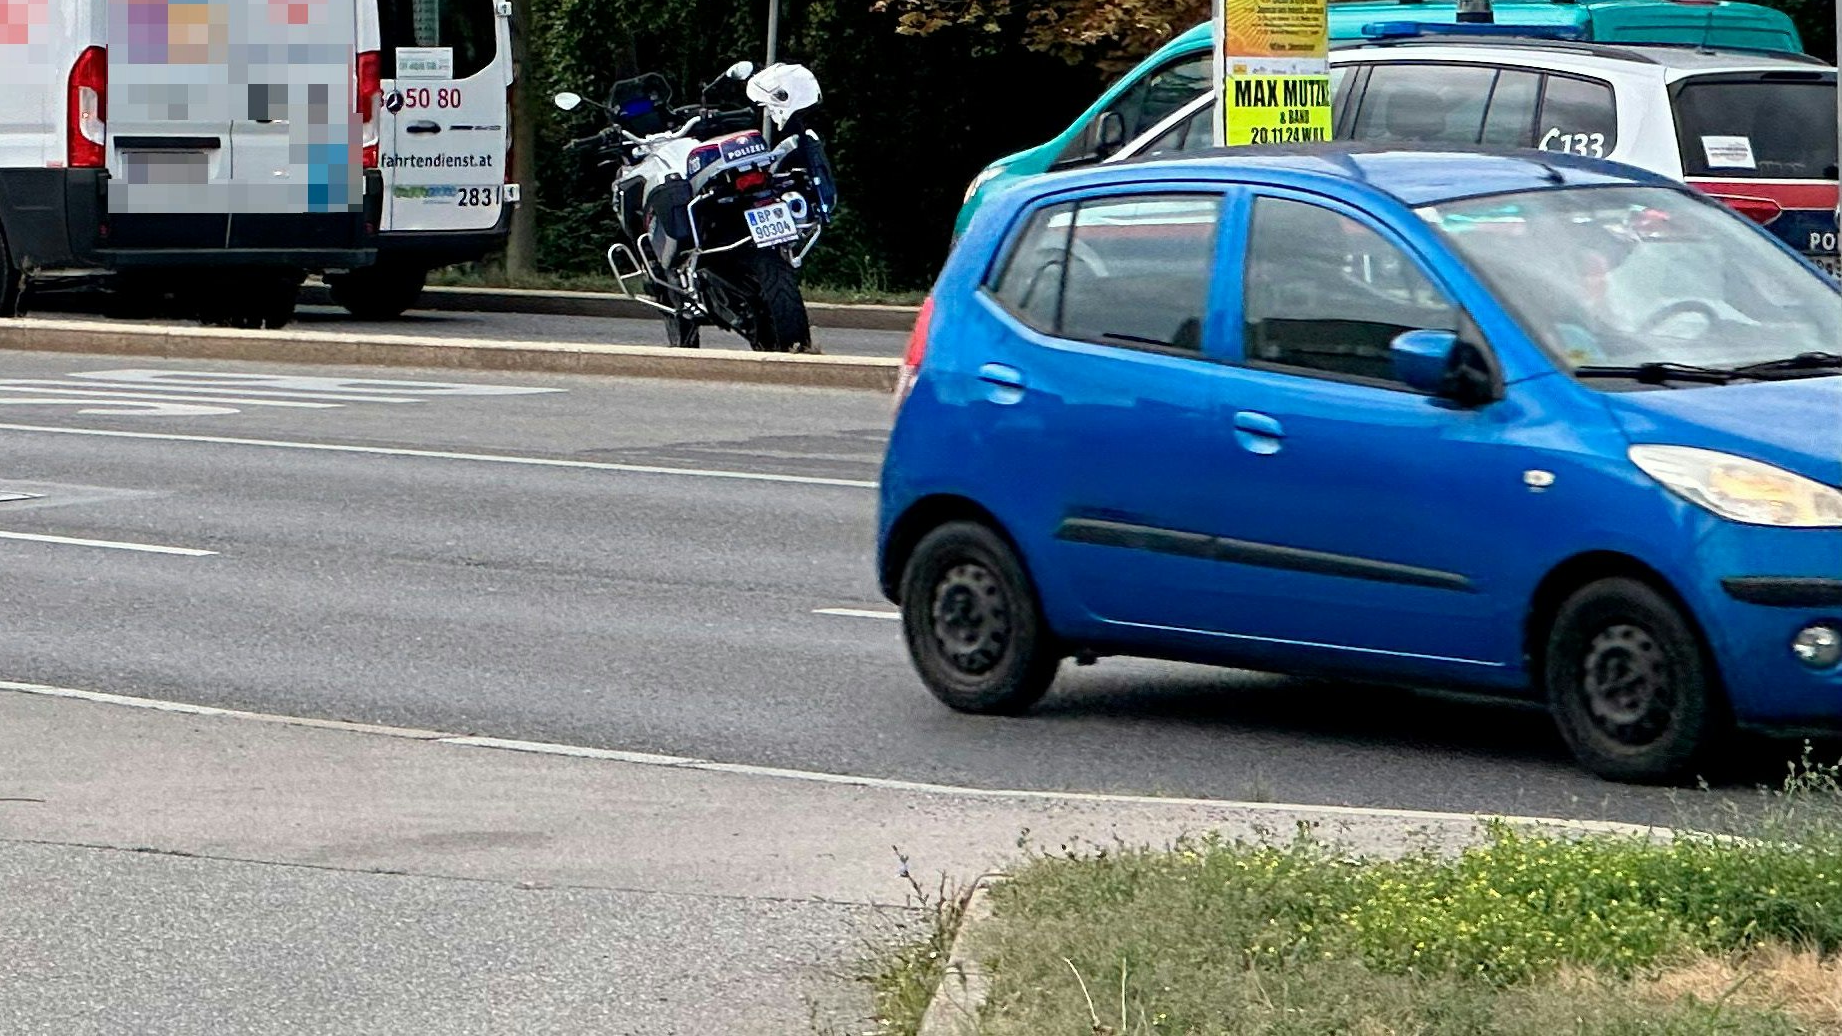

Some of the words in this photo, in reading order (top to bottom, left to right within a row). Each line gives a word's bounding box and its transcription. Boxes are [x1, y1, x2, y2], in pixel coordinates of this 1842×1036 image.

[405, 88, 430, 109] 50
[438, 88, 461, 109] 80
[1235, 79, 1279, 108] MAX
[727, 143, 766, 160] POLIZEI
[1560, 132, 1605, 159] 133
[381, 153, 493, 168] fahrtendienst.at
[755, 221, 791, 240] 90304
